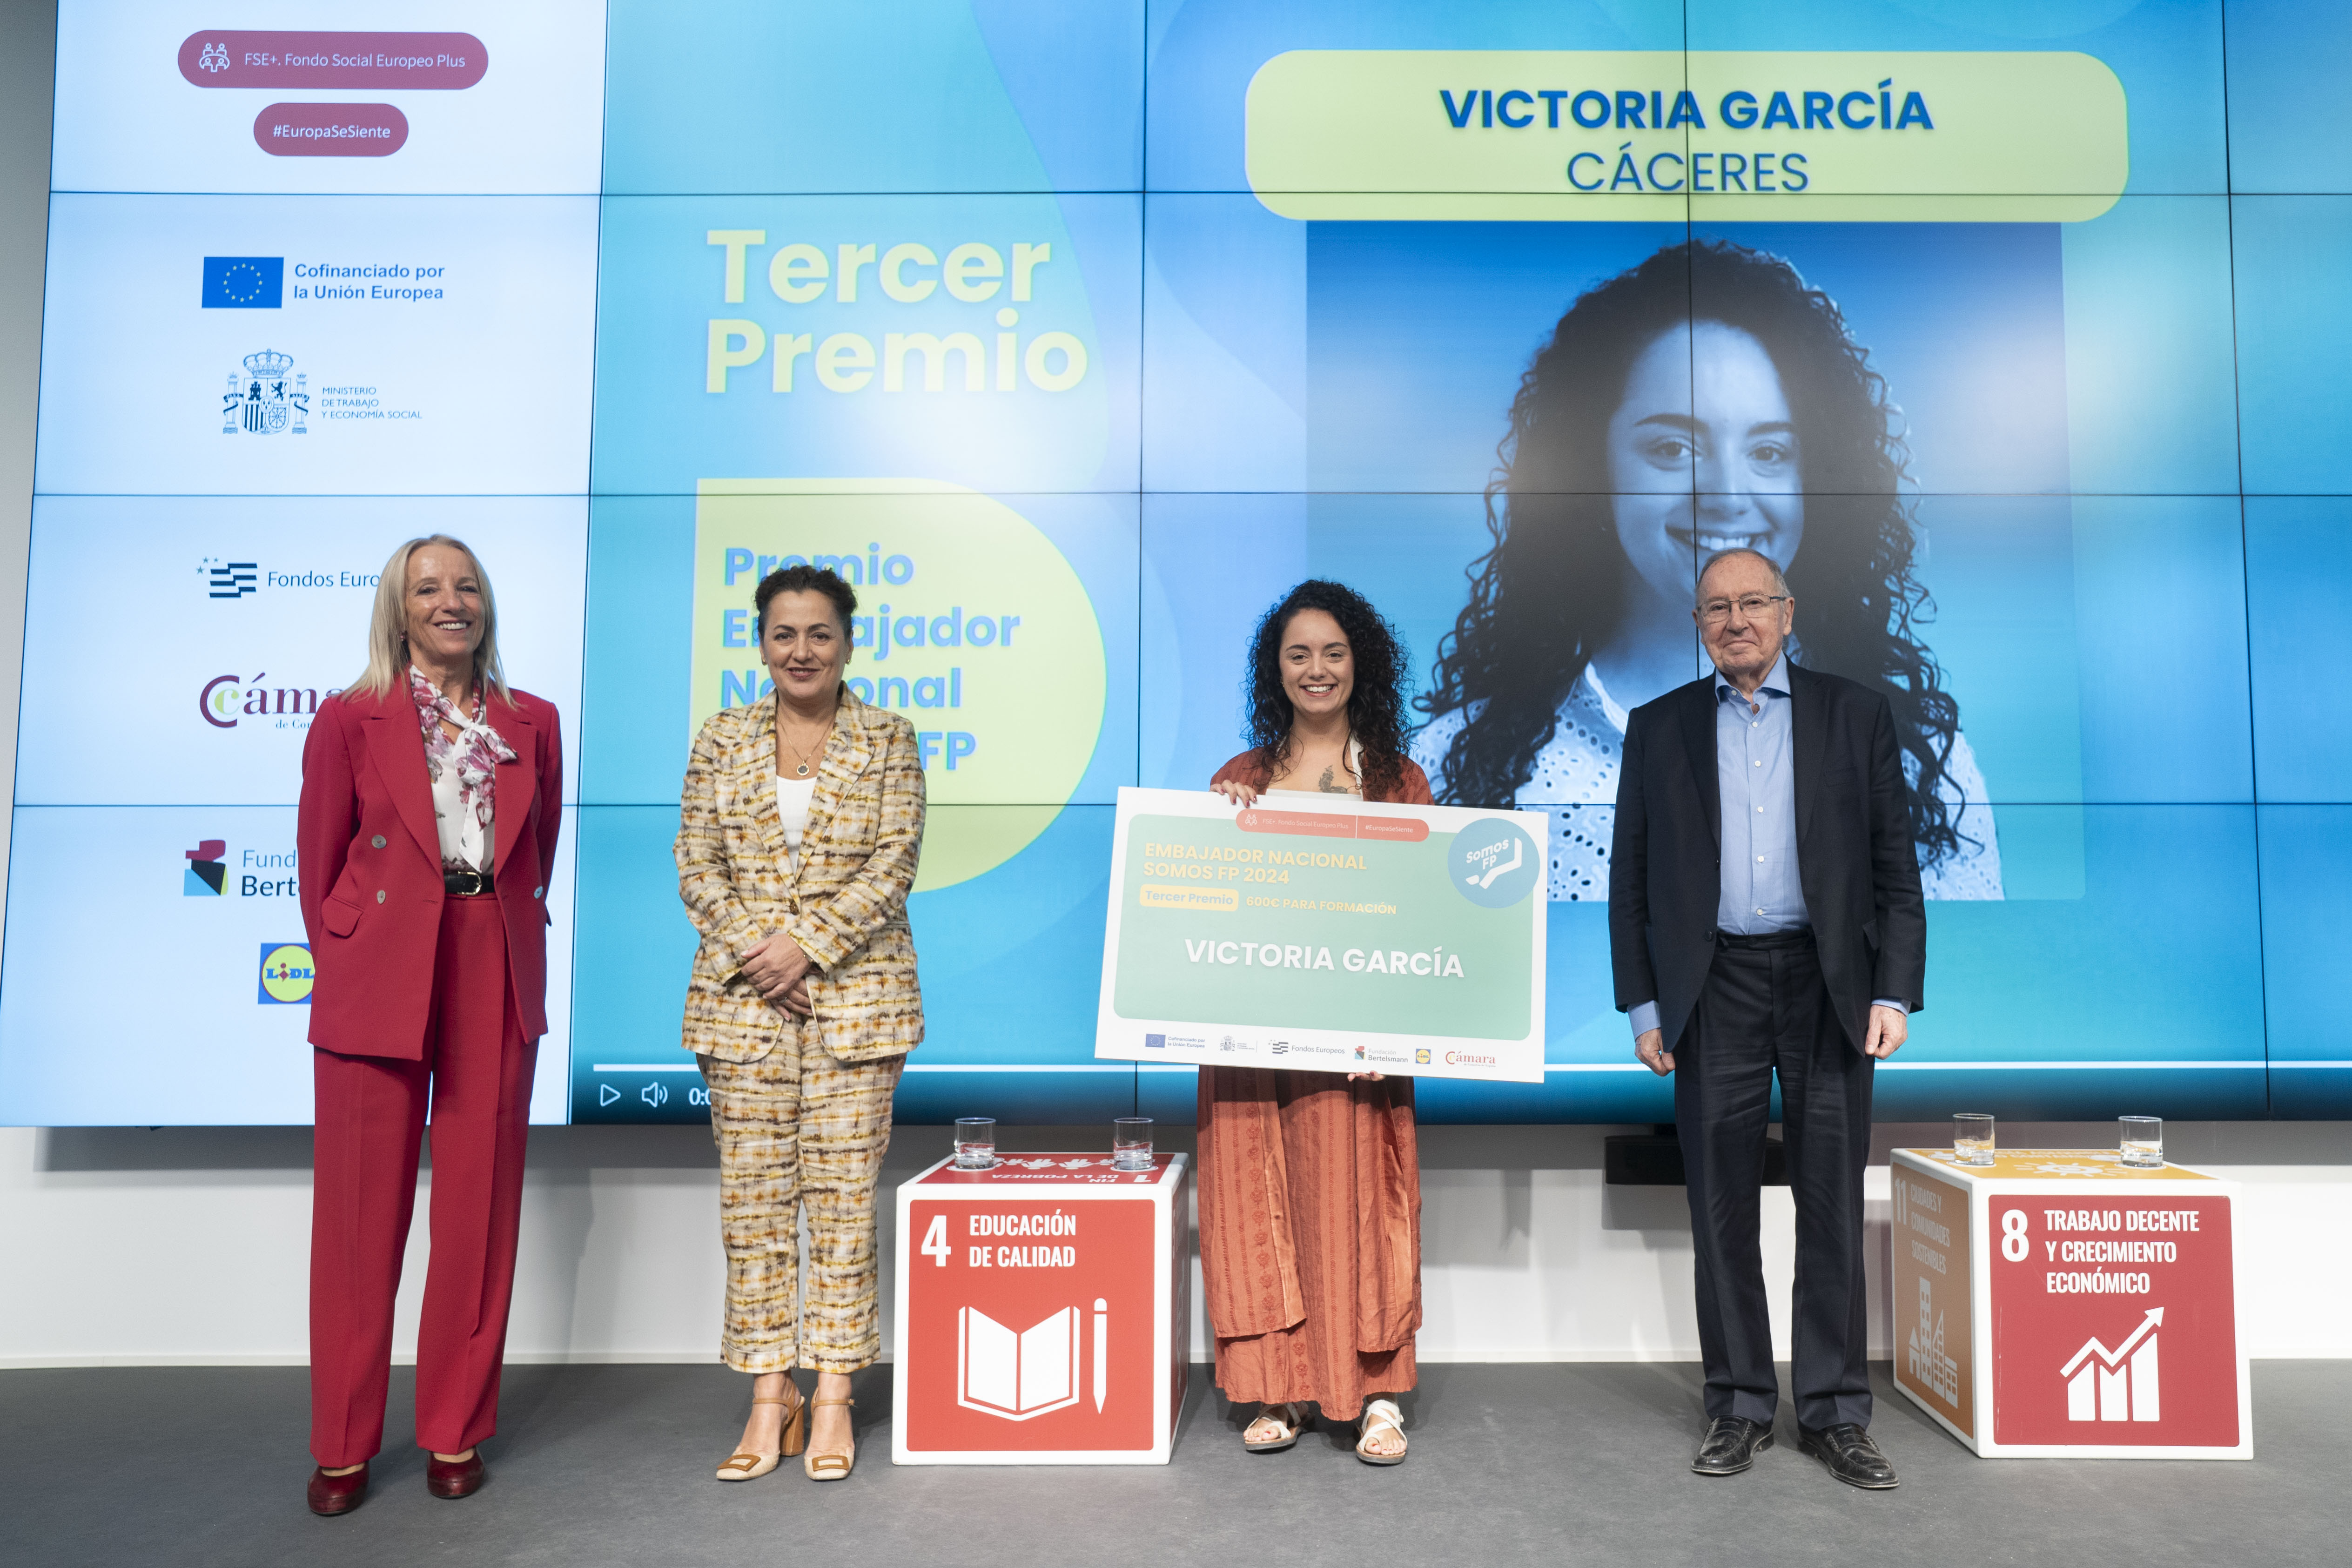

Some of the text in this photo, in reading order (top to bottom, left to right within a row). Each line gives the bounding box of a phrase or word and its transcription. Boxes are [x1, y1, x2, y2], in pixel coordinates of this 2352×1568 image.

[245, 53, 465, 70] FSE+. Fondo Social Europeo Plus
[1439, 77, 1935, 131] VICTORIA GARCÍA
[273, 124, 391, 140] #EuropaSeSiente
[1567, 141, 1809, 192] CÁCERES
[295, 263, 445, 281] Cofinanciado por
[706, 229, 1051, 304] Tercer
[294, 285, 444, 303] la Unión Europea
[706, 307, 1089, 394] Premio
[322, 386, 376, 395] MINISTERIO
[322, 398, 379, 409] DE TRABAJO
[322, 409, 423, 419] Y ECONOMÍA SOCIAL
[268, 570, 334, 587] Fondos
[722, 604, 1021, 661] Eajador
[720, 667, 962, 708] Nonal
[276, 719, 288, 729] de
[917, 732, 976, 770] FP
[1365, 825, 1413, 833] #EuropaSeSiente
[1145, 843, 1367, 870] EMBAJADOR NACIONAL
[1483, 855, 1497, 870] FP
[1143, 862, 1290, 884] SOMOS FP 2024
[241, 875, 300, 896] Bert
[1145, 890, 1234, 905] Tercer Premio
[1246, 896, 1397, 915] 600€ PARA FORMACIÓN
[1184, 938, 1465, 979] VICTORIA GARCÍA
[1445, 1051, 1496, 1065] Cámara
[1895, 1178, 1907, 1225] 11
[1911, 1184, 1942, 1214] CIUDADES Y
[969, 1209, 1076, 1236] EDUCACIÓN
[1911, 1211, 1950, 1248] COMUNIDADES
[2044, 1210, 2200, 1232] TRABAJO DECENTE
[921, 1215, 951, 1267] 4
[2001, 1209, 2029, 1262] 8
[969, 1246, 1075, 1267] DE CALIDAD
[1911, 1239, 1946, 1275] SOSTENIBLES
[2045, 1241, 2177, 1263] Y CRECIMIENTO
[2046, 1266, 2150, 1294] ECONÓMICO
